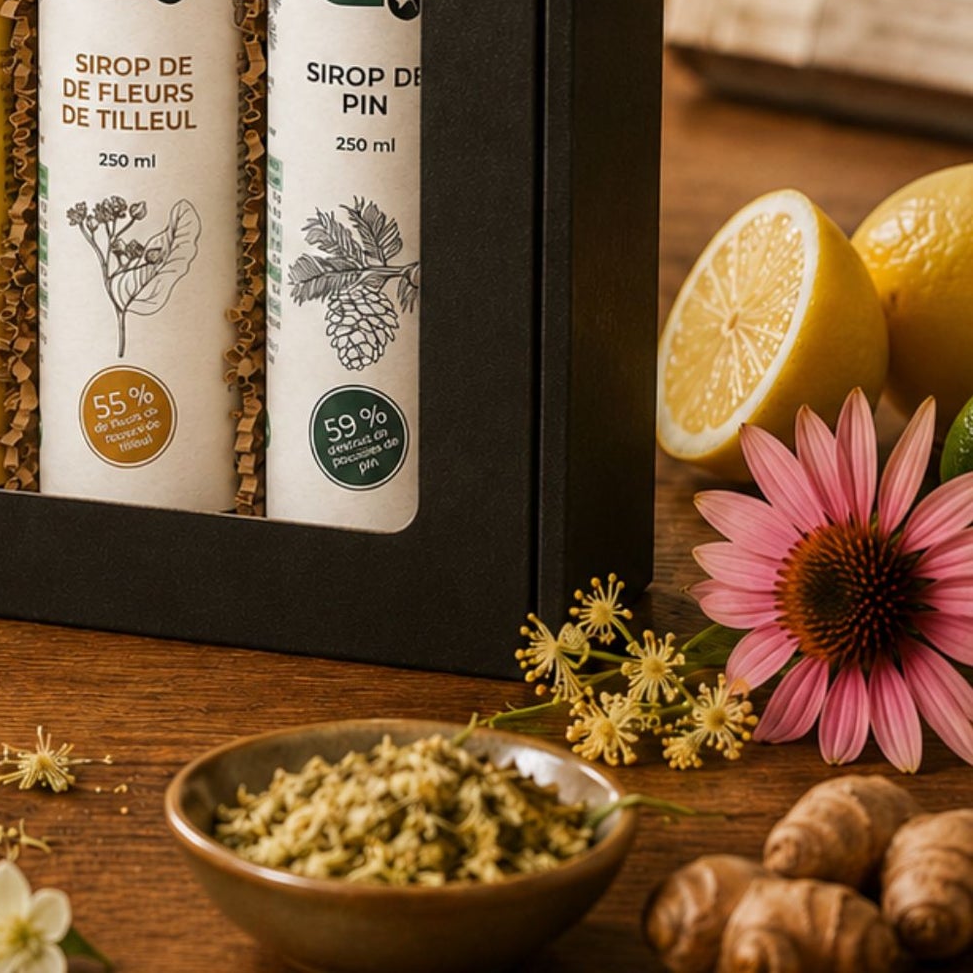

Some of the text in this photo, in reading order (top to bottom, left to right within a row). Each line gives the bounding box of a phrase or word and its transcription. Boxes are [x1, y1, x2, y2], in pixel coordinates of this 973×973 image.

[75, 53, 193, 77] SIROP DE
[306, 62, 385, 87] SIROP
[63, 78, 194, 104] DE FLEURS
[342, 93, 388, 116] PIN
[61, 104, 198, 131] DE TILLEUL
[335, 137, 395, 153] 250 ml
[98, 153, 156, 169] 250 ml
